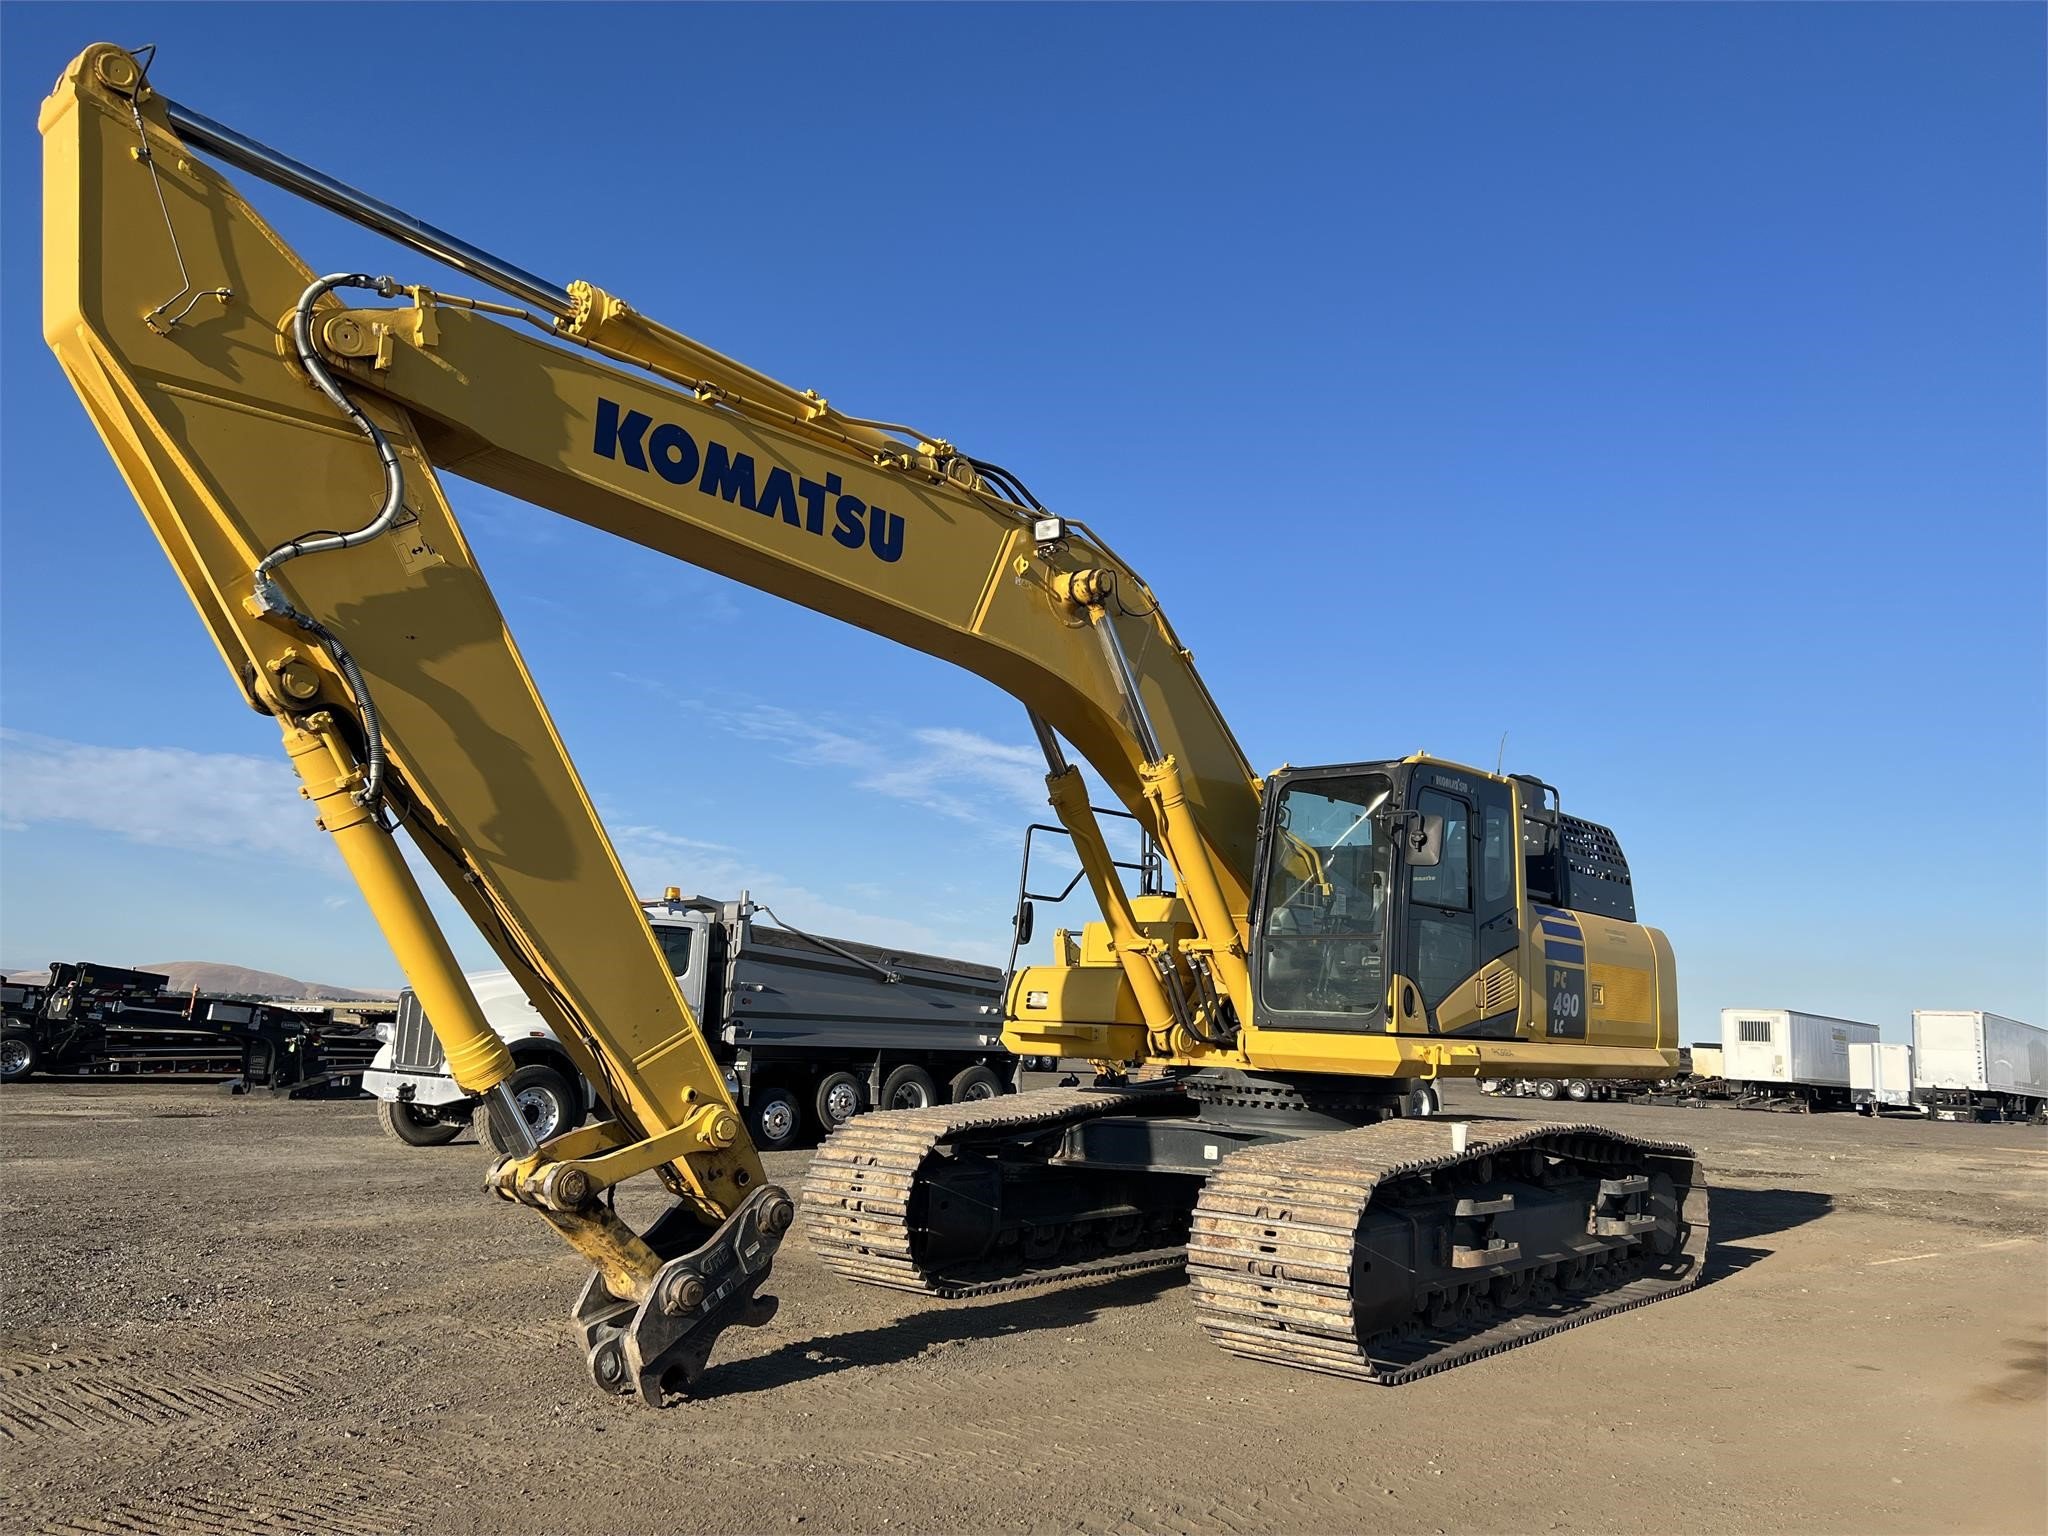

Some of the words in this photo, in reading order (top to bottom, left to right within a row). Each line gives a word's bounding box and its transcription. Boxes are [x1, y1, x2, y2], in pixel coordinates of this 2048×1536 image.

[593, 396, 906, 563] KOMATSU
[1553, 969, 1567, 989] PC
[1553, 992, 1579, 1018] 490
[1553, 1018, 1565, 1034] LC
